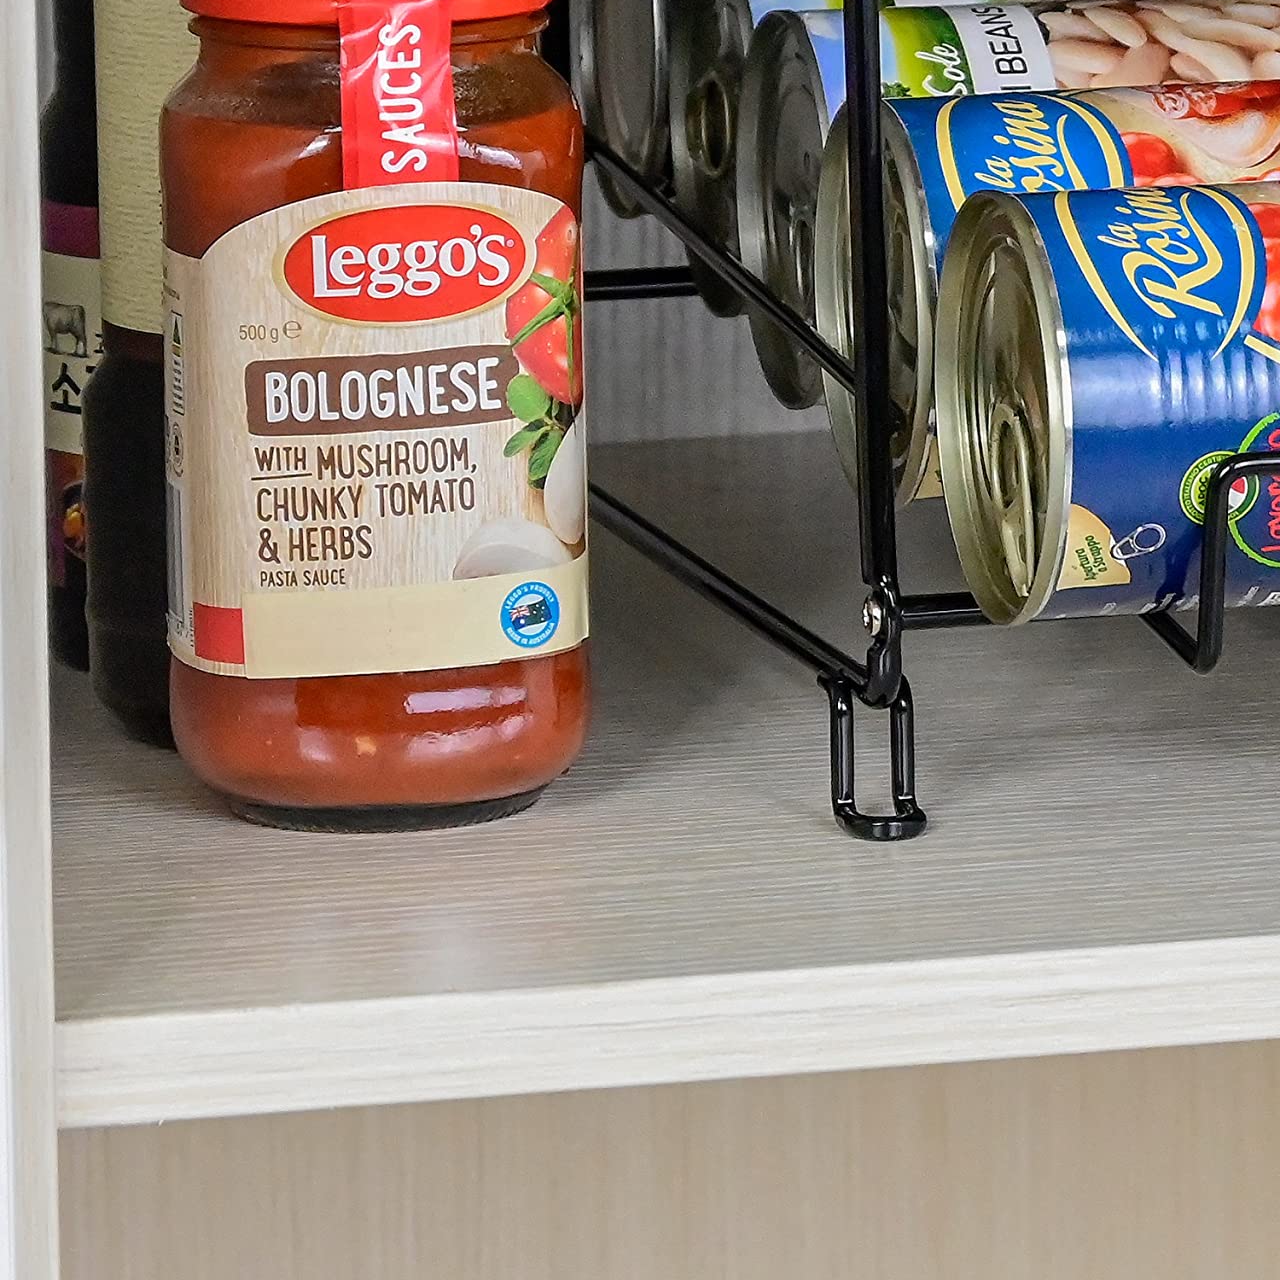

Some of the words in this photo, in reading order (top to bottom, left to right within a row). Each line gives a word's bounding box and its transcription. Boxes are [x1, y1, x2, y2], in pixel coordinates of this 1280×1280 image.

[971, 6, 1029, 75] BEANS
[378, 22, 427, 173] SAUCES
[1097, 221, 1142, 249] la
[310, 224, 512, 301] Leggo's
[238, 322, 268, 342] 500
[269, 328, 280, 345] g
[264, 356, 503, 424] BOLOGNESE
[254, 446, 308, 473] WITH
[316, 437, 478, 480] MUSHROOM,
[256, 485, 364, 523] CHUNKY
[374, 478, 475, 518] TOMATO
[257, 532, 281, 565] &
[288, 526, 374, 562] HERBS
[259, 569, 298, 588] PASTA
[303, 568, 347, 586] SAUCE
